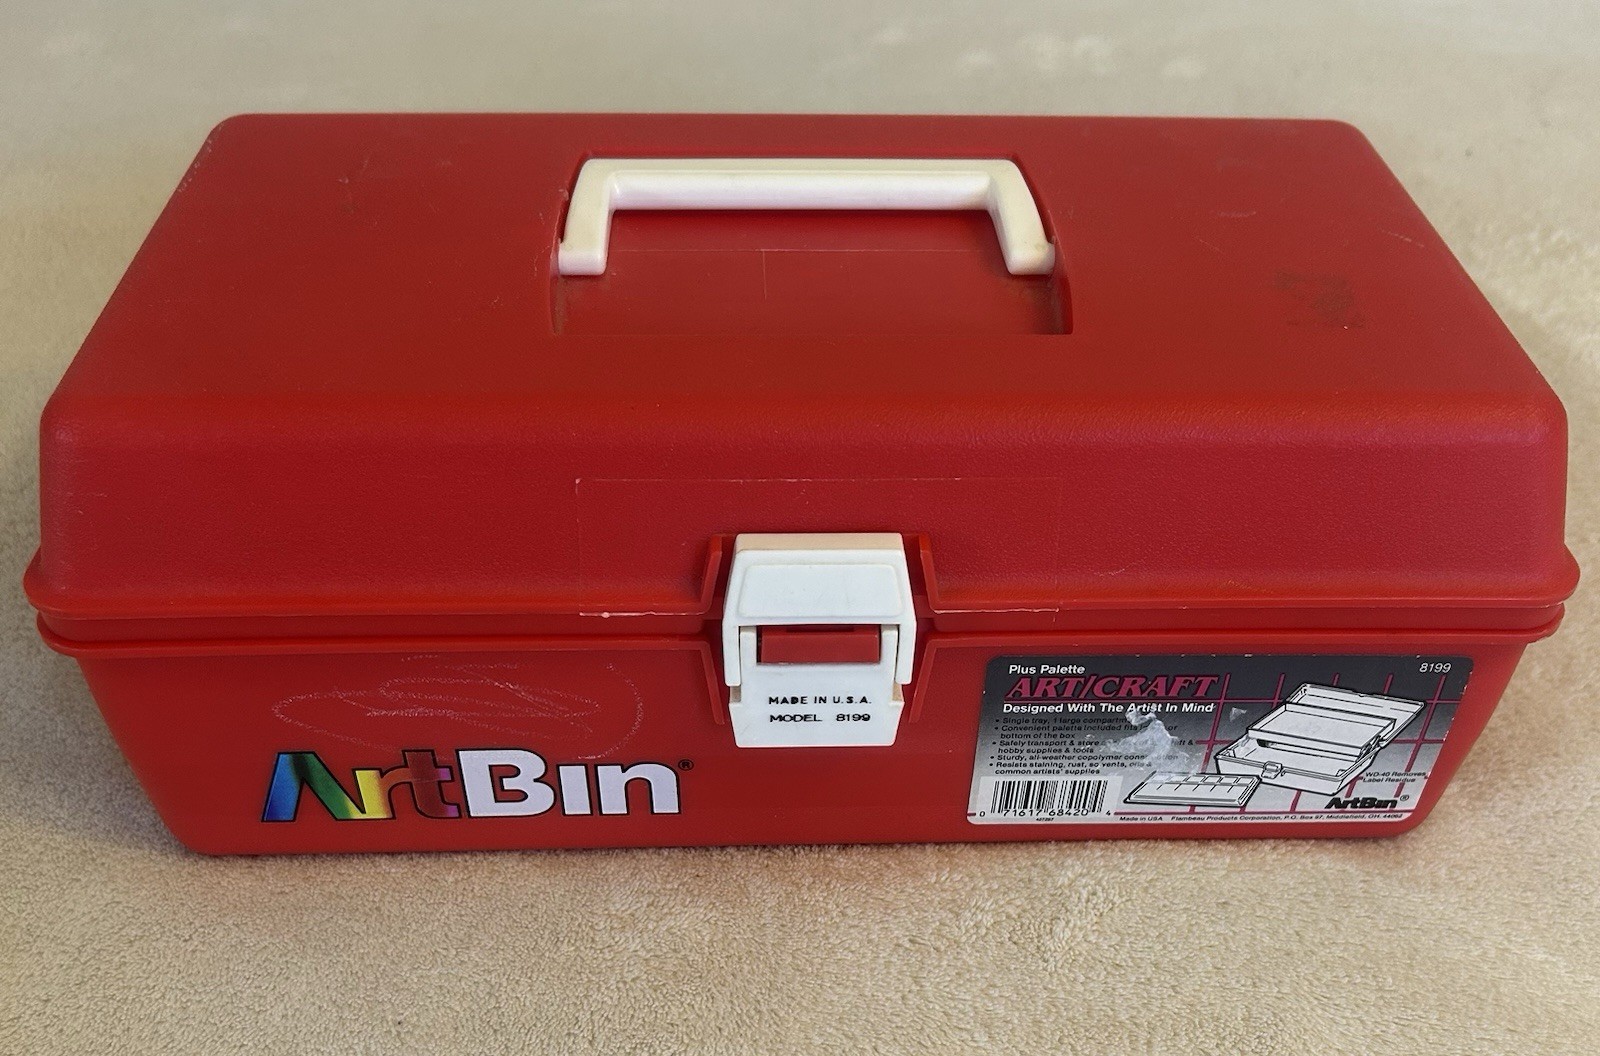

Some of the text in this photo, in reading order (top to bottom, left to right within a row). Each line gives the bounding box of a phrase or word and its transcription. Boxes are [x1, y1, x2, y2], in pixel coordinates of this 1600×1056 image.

[1008, 664, 1086, 675] Plus Palette
[1419, 662, 1452, 674] 8199
[1005, 674, 1219, 700] ART/CRAFT
[768, 695, 872, 705] MADE IN U.S.A.
[1002, 702, 1215, 715] Designed With The Artist In Mind
[769, 713, 871, 722] MODEL 8199
[1003, 717, 1029, 725] Single
[1031, 717, 1050, 725] tray,
[1059, 717, 1081, 725] large
[999, 740, 1026, 748] Safely
[1027, 740, 1067, 748] transport
